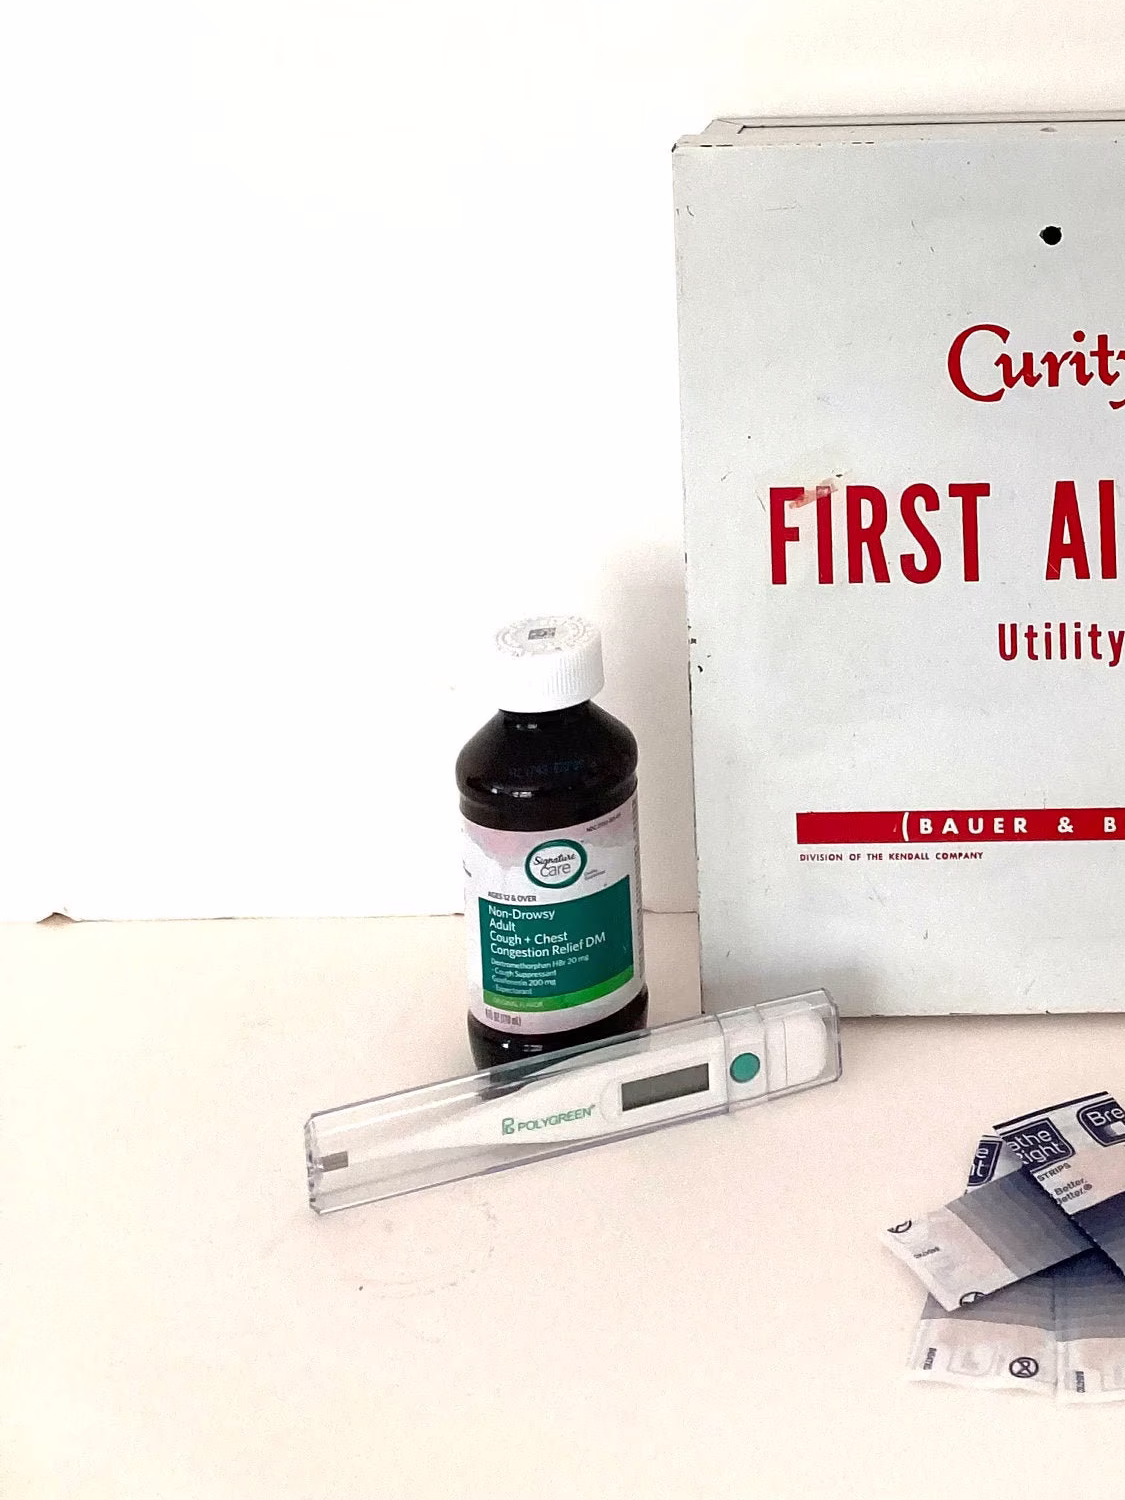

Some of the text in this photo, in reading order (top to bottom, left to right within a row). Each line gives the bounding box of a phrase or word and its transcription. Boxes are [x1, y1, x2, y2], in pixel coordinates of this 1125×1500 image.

[769, 483, 990, 585] FIRST
[998, 621, 1125, 668] Utility
[1057, 815, 1075, 834] &
[800, 851, 984, 862] DIVISION OF THE KENDALL COMPANY
[488, 904, 556, 921] Non-Drowsy
[489, 918, 516, 932] Adult
[490, 930, 522, 947] Cough
[534, 931, 568, 945] Chest
[490, 931, 606, 959] Congestion Relief DM
[528, 979, 543, 987] 200
[518, 1107, 592, 1132] POLYGREEN
[1036, 1162, 1072, 1182] STRIPS
